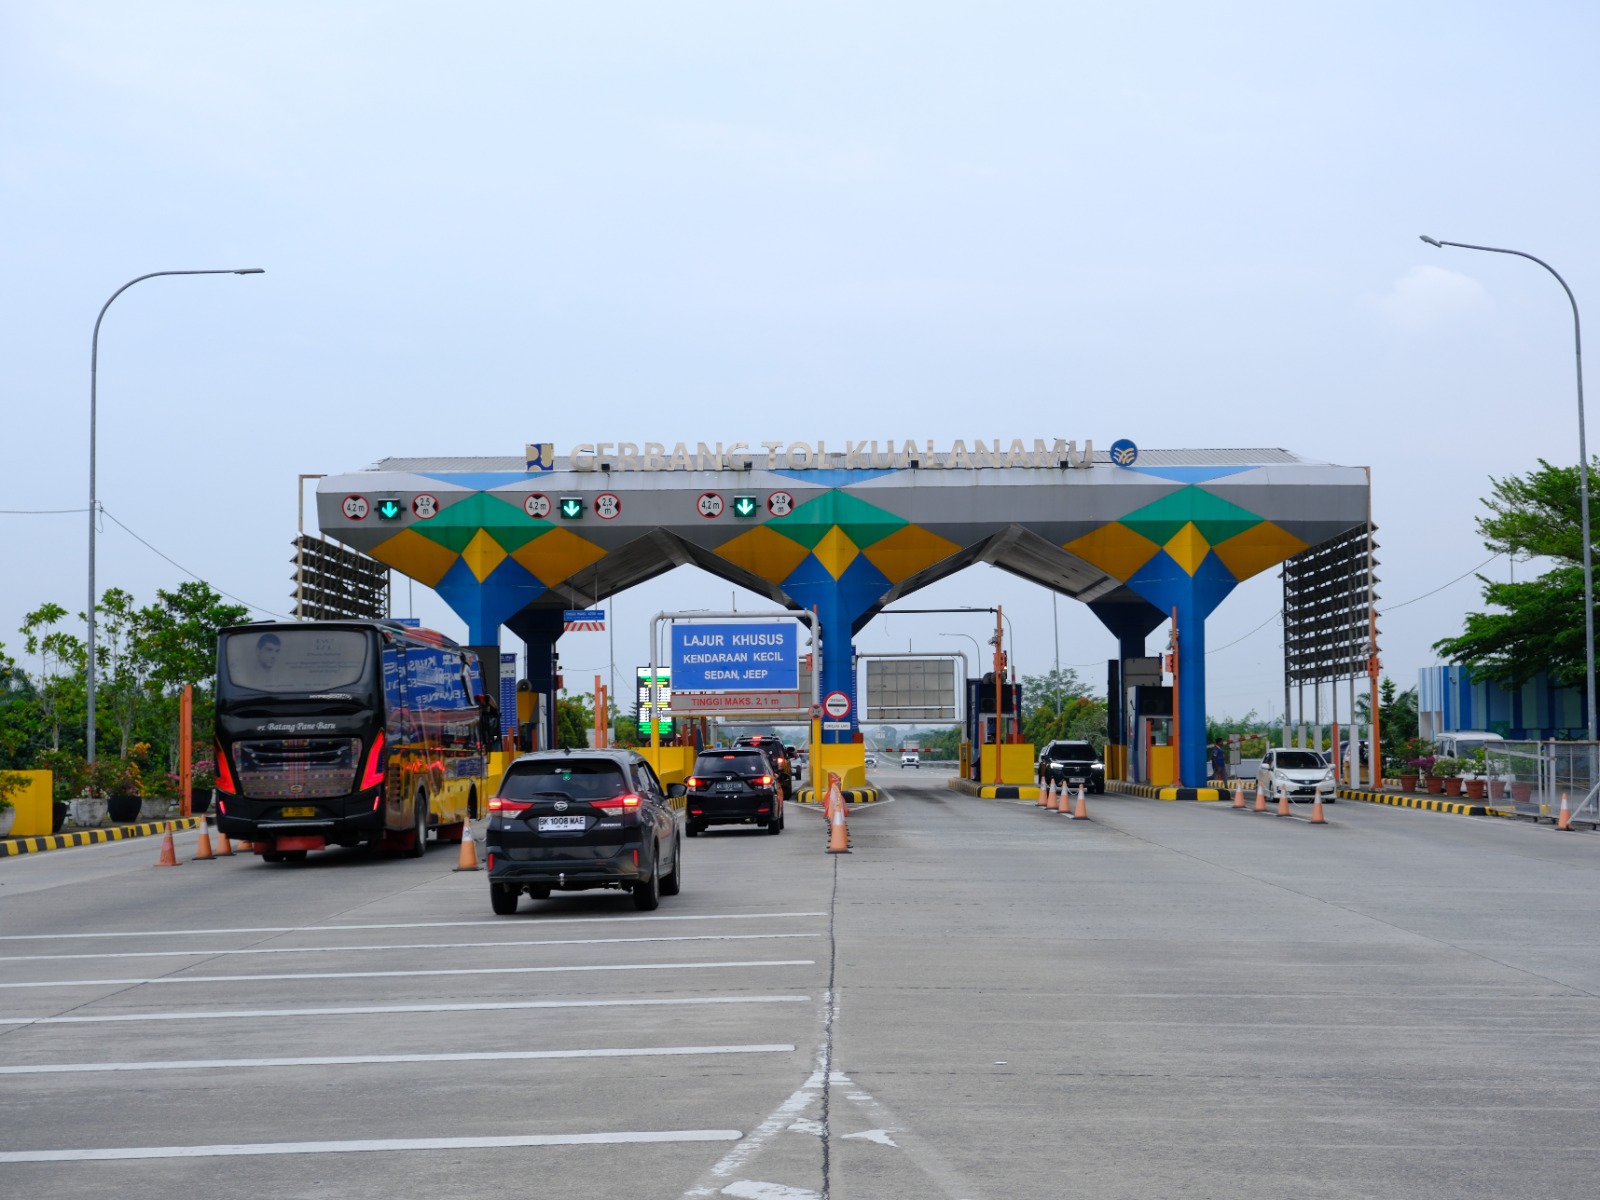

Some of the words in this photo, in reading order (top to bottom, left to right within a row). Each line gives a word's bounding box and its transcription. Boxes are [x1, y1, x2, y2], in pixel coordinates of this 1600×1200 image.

[570, 441, 752, 471] GERBANG
[761, 440, 835, 471] TOL
[846, 438, 1094, 469] KUALANAMU
[420, 497, 431, 507] 2,5
[602, 497, 613, 507] 2,5
[775, 495, 786, 505] 2,5
[346, 503, 357, 513] 4,2
[358, 504, 365, 512] m
[528, 501, 539, 511] 4,2
[540, 502, 547, 510] m
[701, 500, 712, 511] 4,2
[712, 502, 720, 510] m
[777, 505, 785, 513] m
[422, 507, 429, 515] m
[604, 507, 612, 515] m
[683, 634, 725, 647] LAJUR
[732, 633, 784, 646] KHUSUS
[683, 652, 748, 664] KENDARAAN
[753, 651, 784, 662] KECIL
[704, 669, 740, 680] SEDAN,
[742, 669, 768, 679] JEEP
[691, 697, 722, 706] TINGGI
[267, 722, 295, 733] Batang
[295, 722, 316, 731] Pane
[316, 721, 337, 731] Baru
[540, 817, 550, 826] BK
[550, 817, 569, 825] 1008
